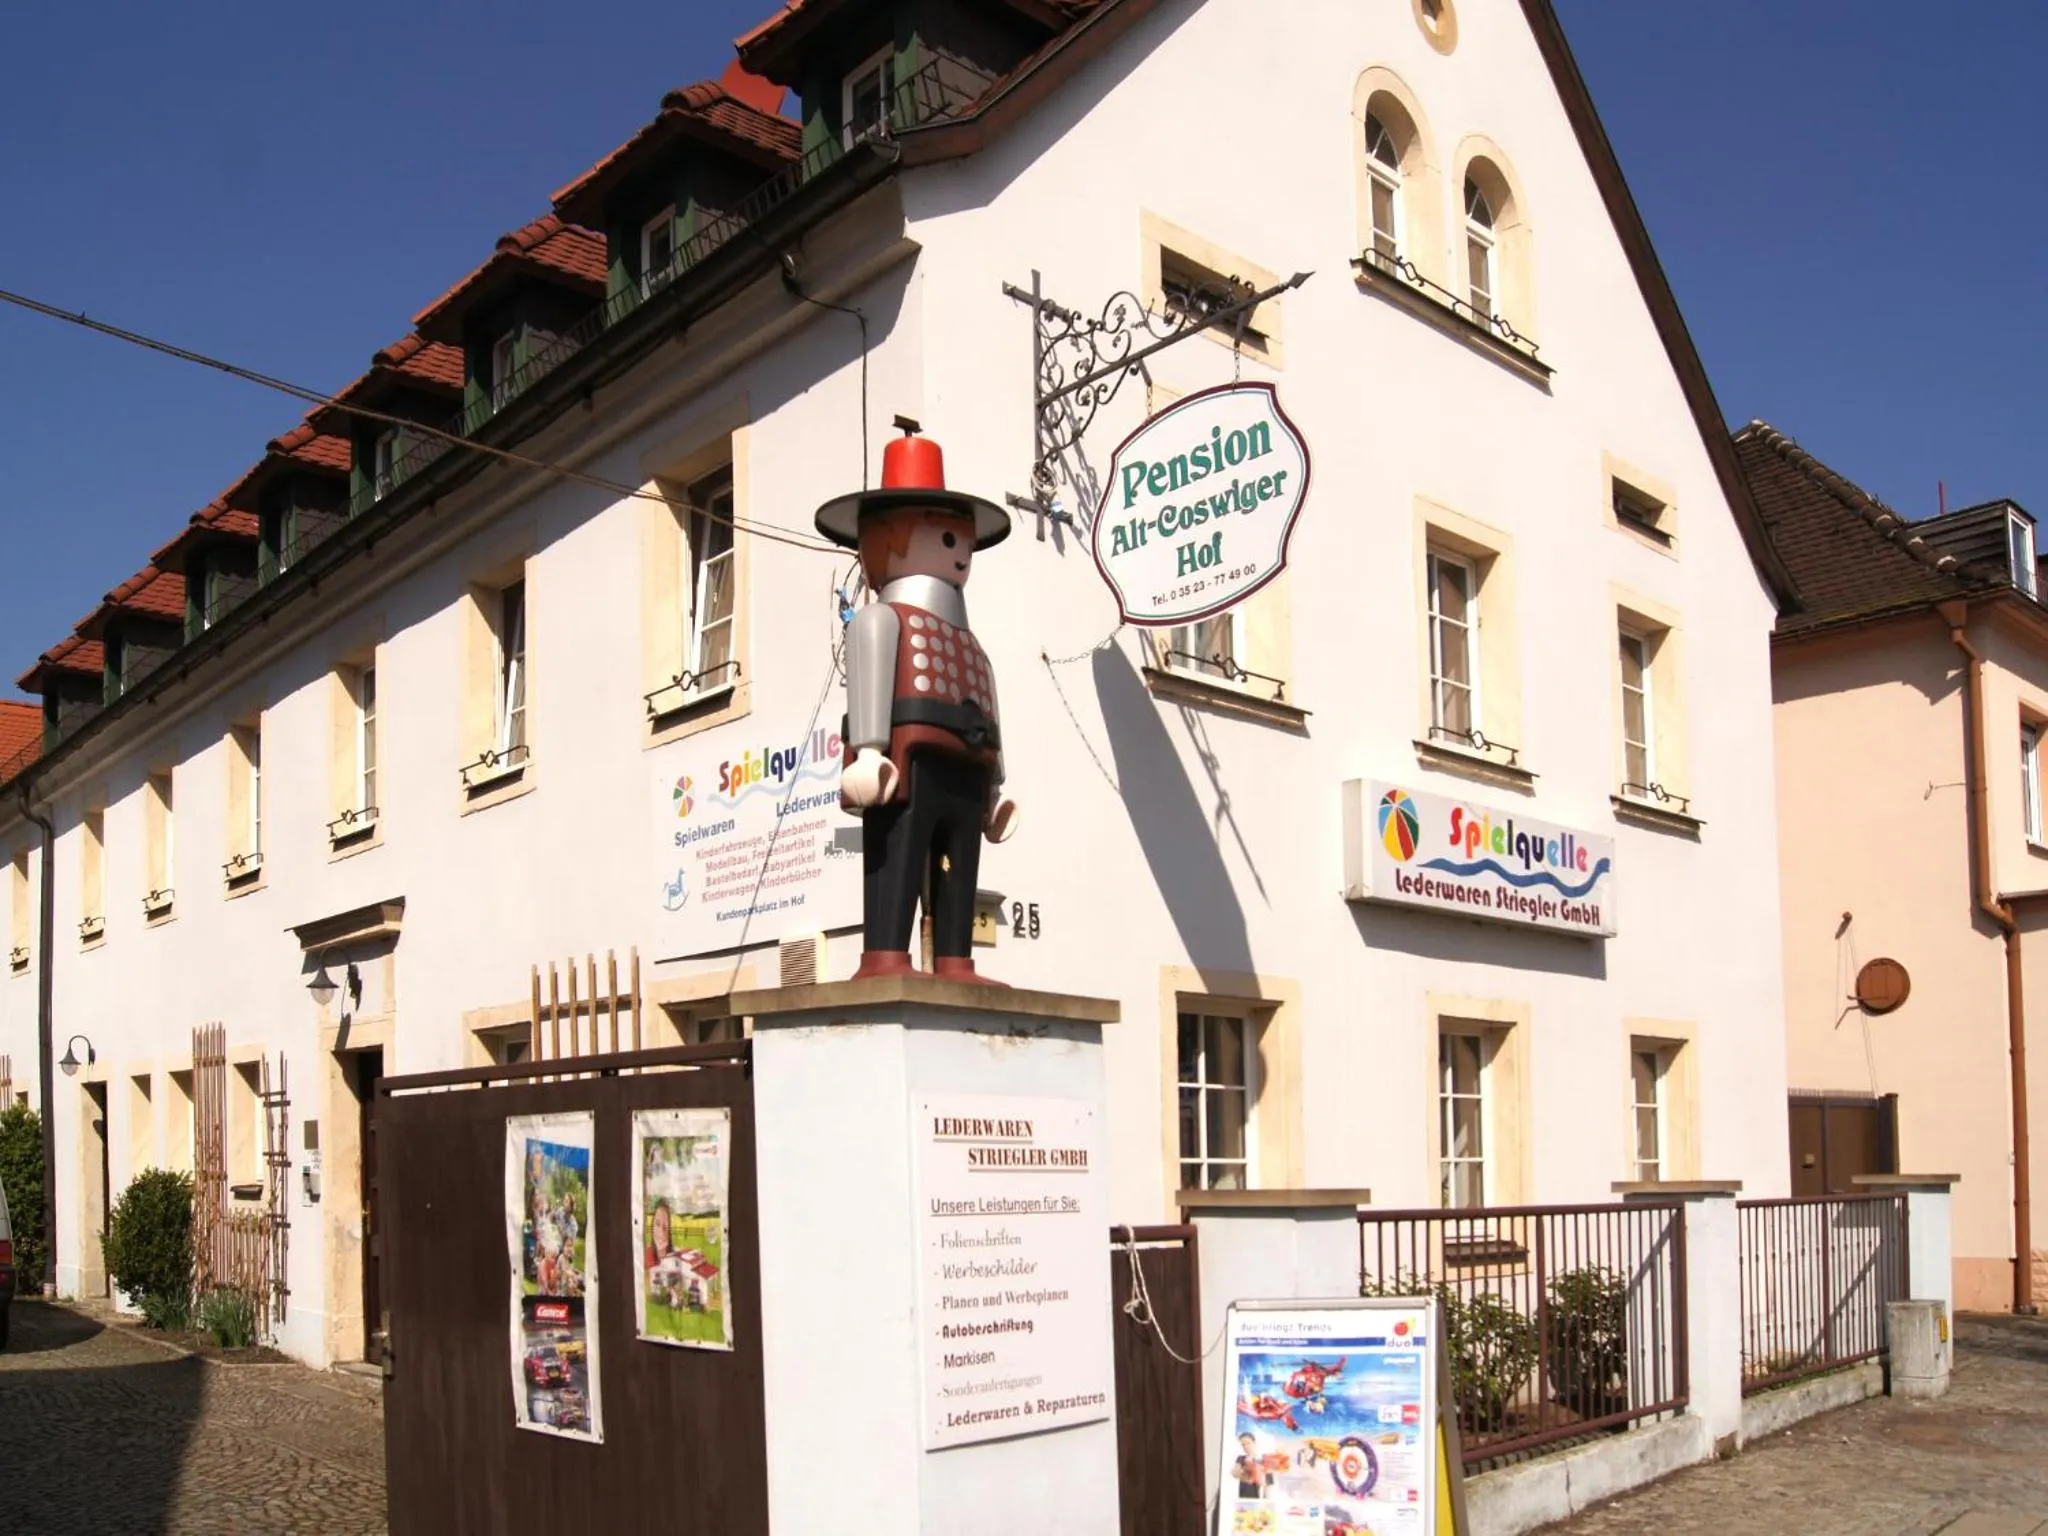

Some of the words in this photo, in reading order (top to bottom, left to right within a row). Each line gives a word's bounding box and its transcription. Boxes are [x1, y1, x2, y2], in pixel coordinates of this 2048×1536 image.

[1121, 420, 1274, 510] Pension
[1111, 470, 1287, 557] Alt-Coswiger
[1176, 531, 1223, 578] Hof
[1152, 593, 1168, 607] Tel.
[1170, 590, 1177, 601] 0
[1179, 585, 1191, 598] 35
[1194, 580, 1205, 593] 23
[1214, 572, 1226, 586] 77
[1228, 568, 1241, 581] 49
[1243, 563, 1257, 576] 00
[776, 788, 842, 818] Lederware
[675, 818, 735, 848] Spielwaren
[768, 818, 827, 842] Esenbahnen
[1449, 806, 1588, 873] Spielquelle
[752, 835, 815, 861] Frezeitartikel
[760, 867, 822, 889] Kinderbücher
[779, 897, 789, 909] im
[791, 894, 805, 906] Hof
[1396, 867, 1492, 907] Lederwaren
[1496, 886, 1557, 922] Striegler
[1560, 898, 1601, 927] GmbH
[1012, 901, 1041, 935] 25
[933, 1117, 1034, 1138] LEDERWAREN
[968, 1148, 1047, 1166] STRIEGLER
[1050, 1149, 1089, 1167] GMBH
[931, 1198, 976, 1214] Unsere
[979, 1196, 1042, 1215] Leistungen
[1043, 1195, 1059, 1210] für
[1061, 1195, 1081, 1211] Sie:
[941, 1227, 1022, 1249] Folienschriften
[942, 1256, 1038, 1280] Werbeschilder
[942, 1294, 980, 1310] Planen
[982, 1290, 1004, 1307] und
[1005, 1287, 1070, 1306] Werbeplanen
[942, 1317, 1035, 1339] Autobeschriftung
[1387, 1336, 1412, 1348] duo
[944, 1350, 996, 1369] Markisen
[947, 1403, 1021, 1428] Lederwaren
[1023, 1400, 1035, 1416] &
[1037, 1390, 1107, 1415] Reparaturen
